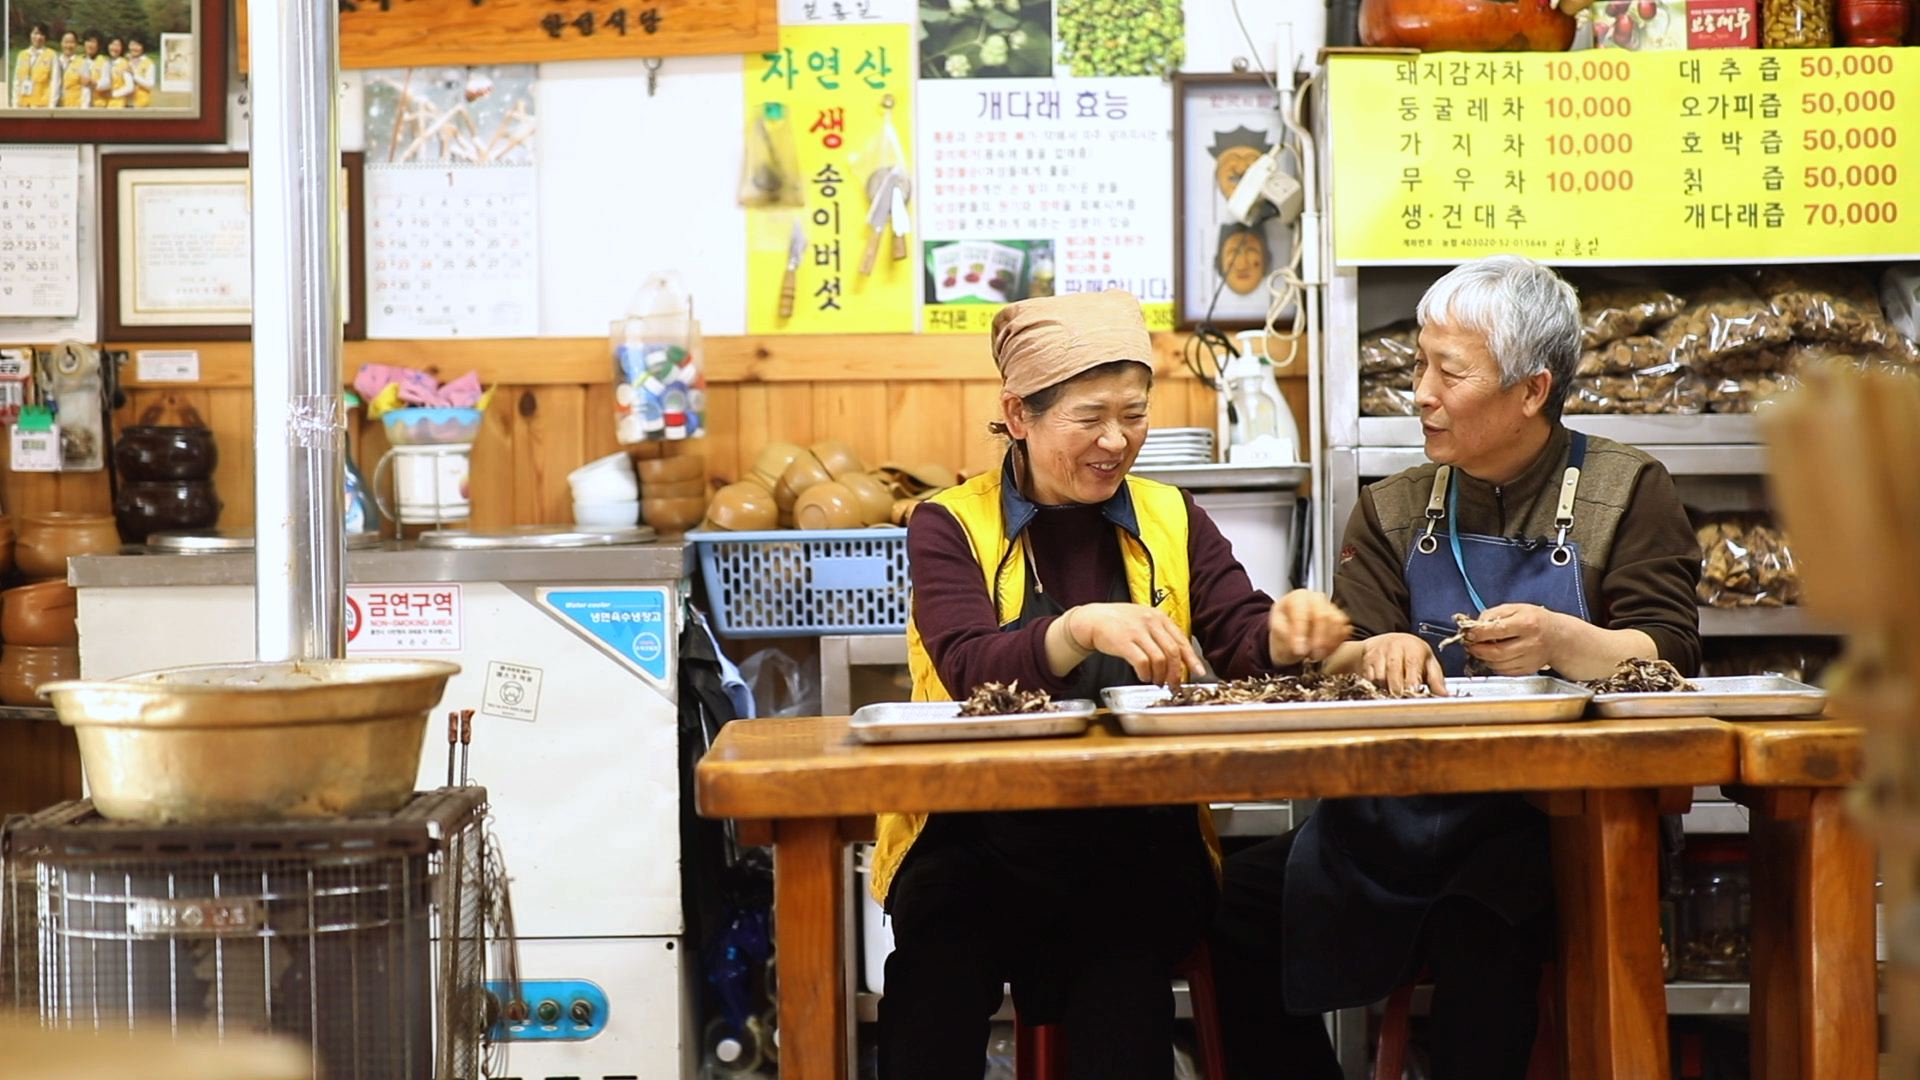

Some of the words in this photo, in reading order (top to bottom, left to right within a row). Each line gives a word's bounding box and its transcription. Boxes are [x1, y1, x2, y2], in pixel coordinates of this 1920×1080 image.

[760, 47, 893, 90] 자연산
[1397, 60, 1524, 87] 돼지감자차
[1546, 61, 1631, 82] 10,000
[1801, 55, 1894, 79] 50,000
[978, 91, 1060, 120] 개다래
[1076, 91, 1128, 120] 효능
[1546, 97, 1632, 119] 10,000
[1680, 93, 1782, 120] 오가피즙
[1802, 90, 1896, 115] 50,000
[809, 107, 844, 149] 생
[1804, 127, 1897, 152] 50,000
[1547, 133, 1633, 156] 10,000
[1547, 170, 1634, 193] 10,000
[1804, 164, 1898, 189] 50,000
[1684, 201, 1786, 230] 개다래즙
[1804, 202, 1898, 227] 70,000
[812, 163, 844, 311] 송이버섯
[368, 592, 452, 617] 금연구역
